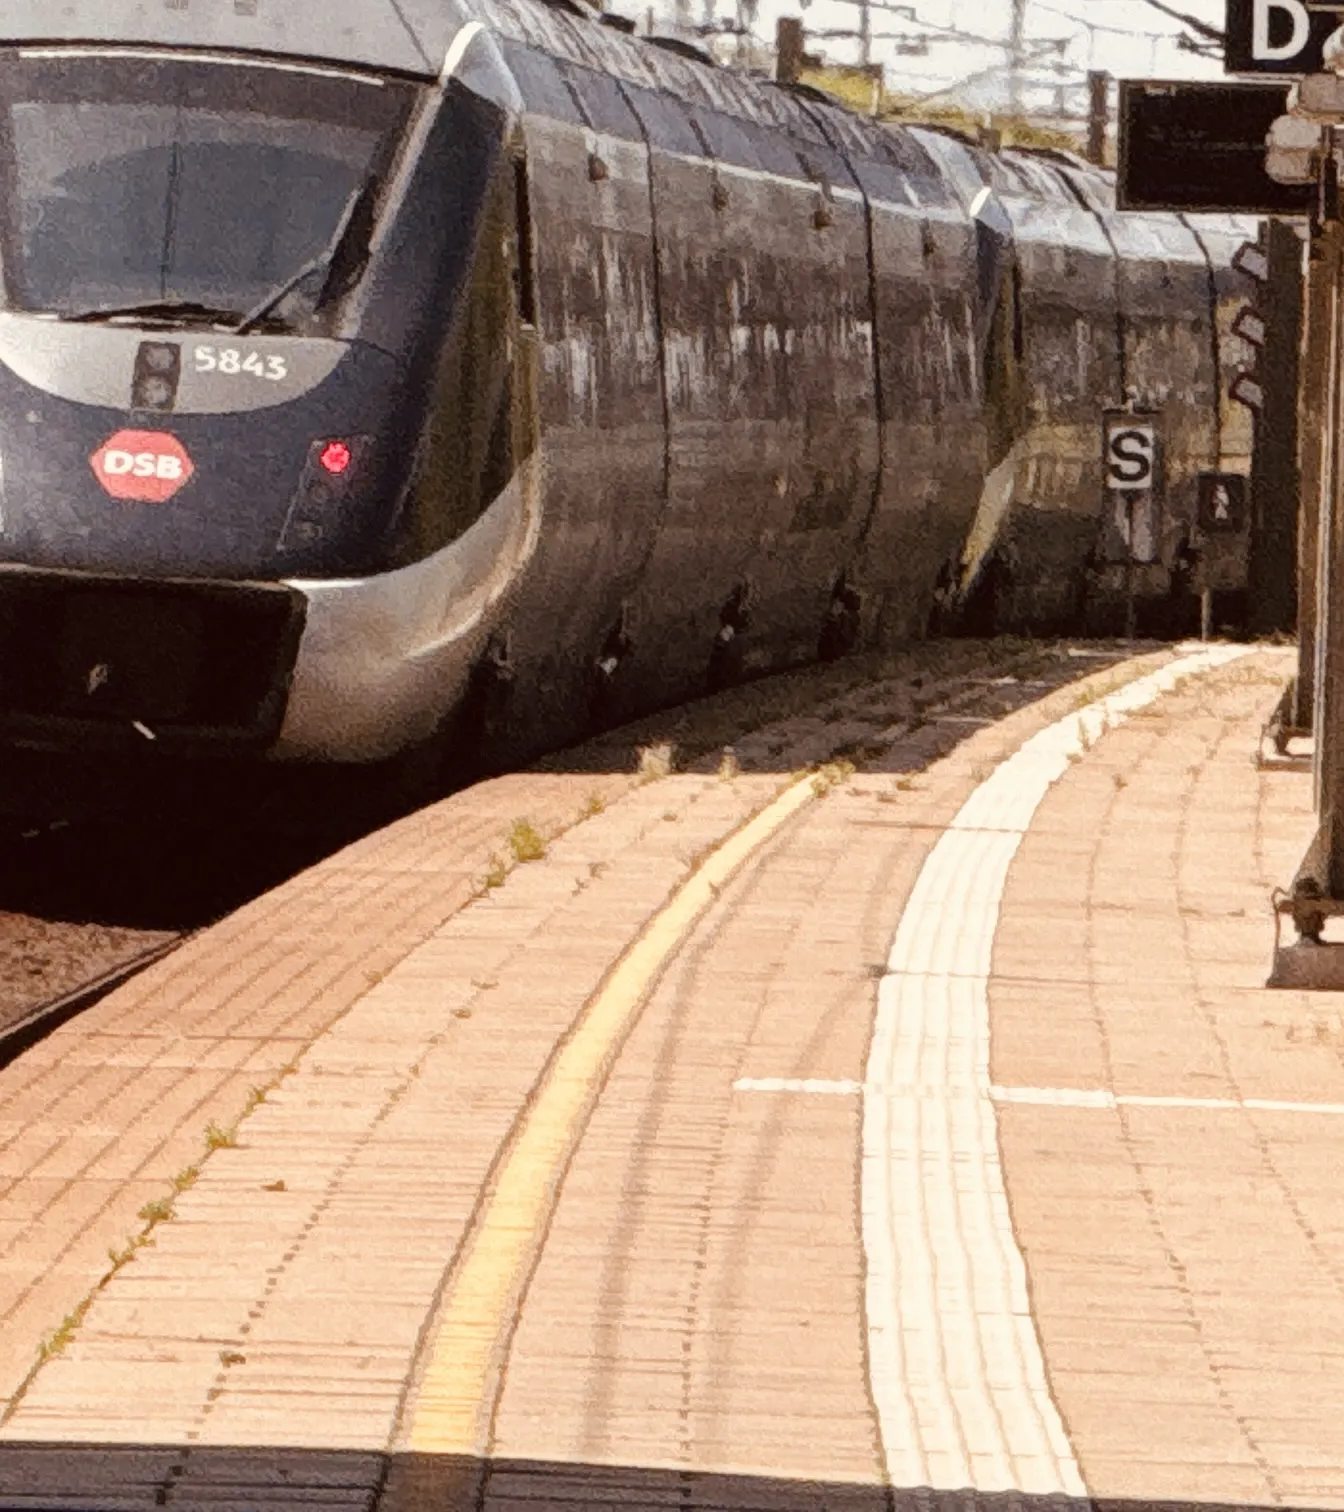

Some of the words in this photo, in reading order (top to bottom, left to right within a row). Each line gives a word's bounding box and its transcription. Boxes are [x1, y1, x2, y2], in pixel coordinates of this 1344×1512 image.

[194, 345, 288, 381] 5843
[103, 450, 184, 480] DSB
[1110, 430, 1152, 482] S
